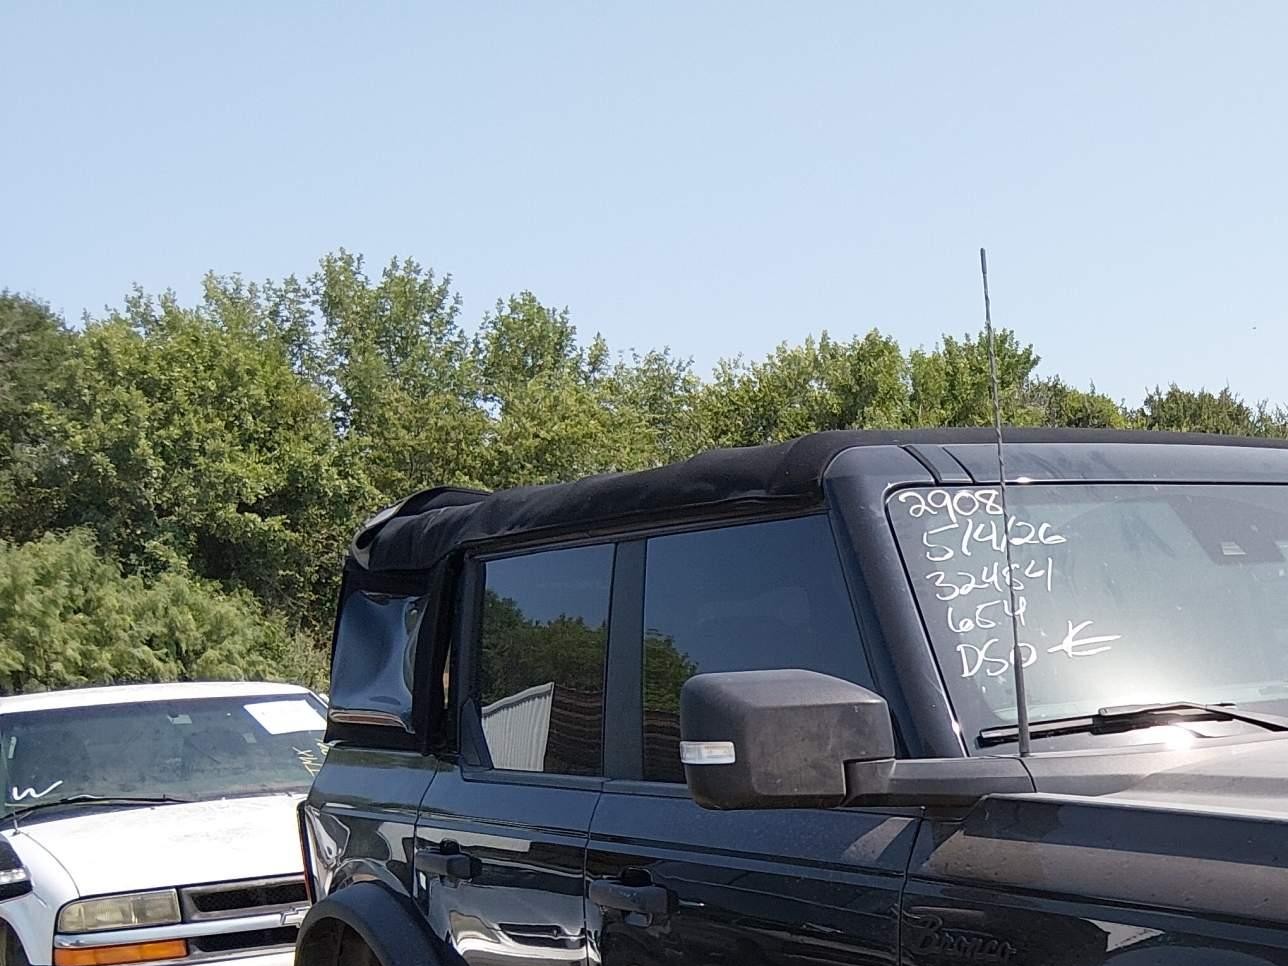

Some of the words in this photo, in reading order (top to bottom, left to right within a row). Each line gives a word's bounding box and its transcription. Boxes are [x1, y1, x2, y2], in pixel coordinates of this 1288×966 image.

[898, 489, 1005, 523] 2908
[922, 516, 1067, 562] 5/4/26
[947, 596, 1026, 633] 654
